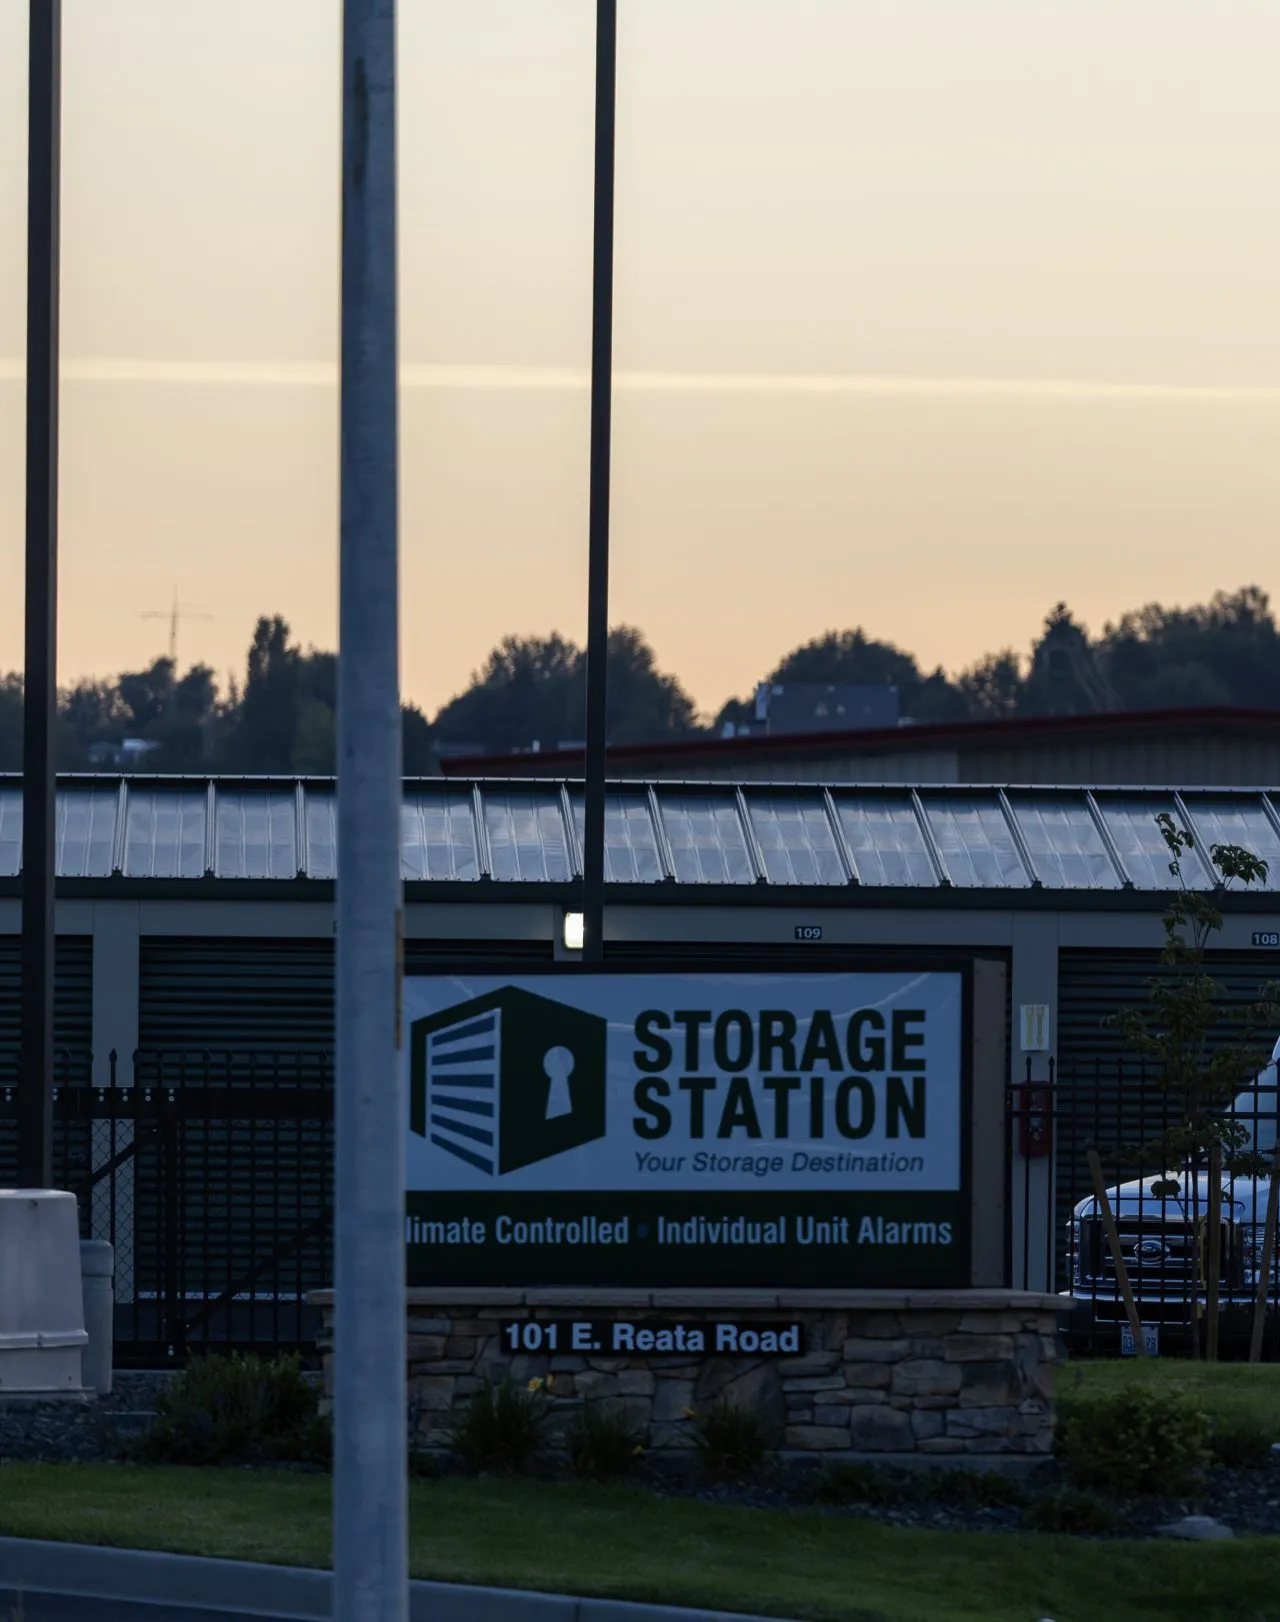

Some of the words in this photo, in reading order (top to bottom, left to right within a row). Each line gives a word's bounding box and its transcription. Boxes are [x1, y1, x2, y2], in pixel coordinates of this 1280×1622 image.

[796, 927, 821, 938] 109
[1254, 934, 1278, 945] 108
[633, 1009, 926, 1073] STORAGE
[633, 1077, 926, 1139] STATION
[635, 1152, 686, 1173] Your
[692, 1152, 783, 1177] Storage
[791, 1151, 924, 1173] Destination
[405, 1216, 486, 1245] limate
[495, 1215, 629, 1245] Controlled
[657, 1215, 786, 1245] Individual
[796, 1216, 849, 1245] Unit
[857, 1216, 953, 1246] Alarms
[505, 1322, 559, 1350] 101
[571, 1323, 602, 1350] E.
[612, 1323, 705, 1352] Reata
[716, 1324, 800, 1353] Road
